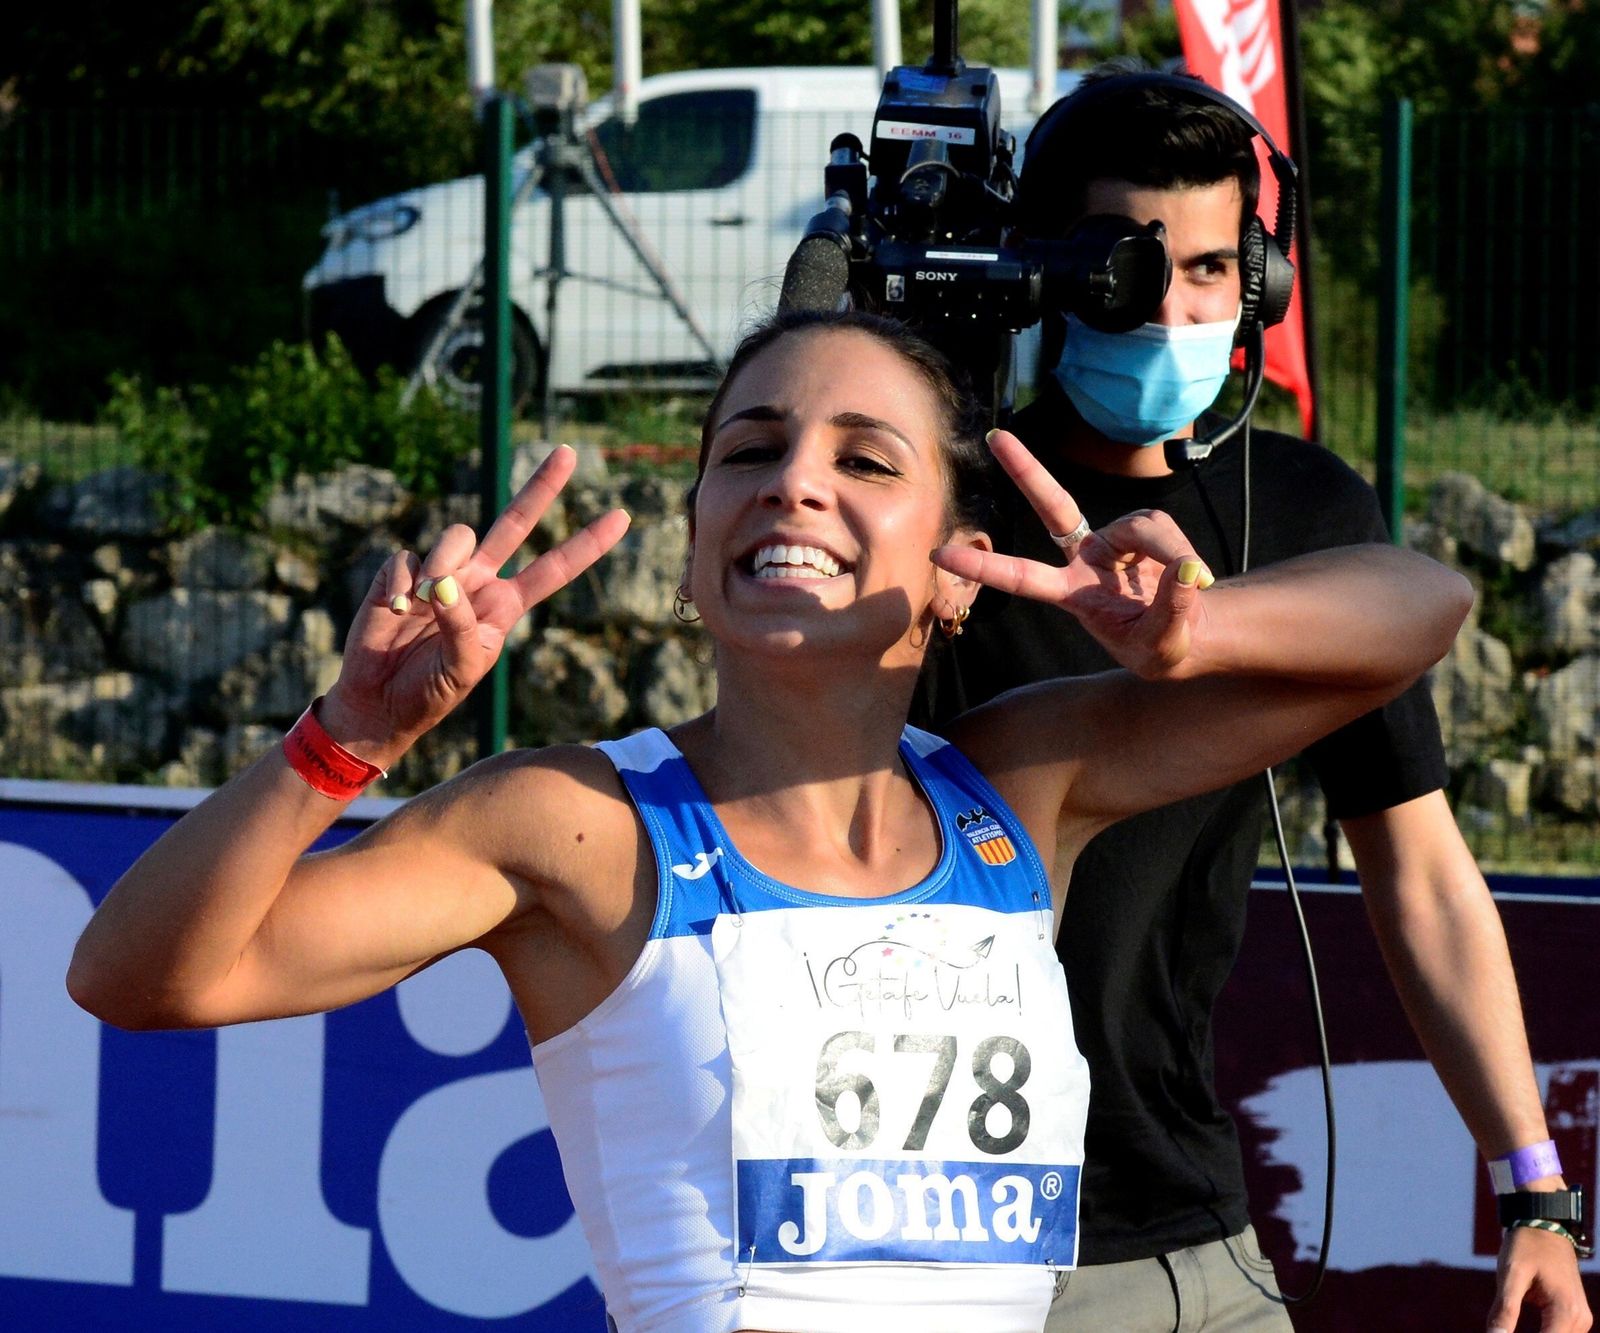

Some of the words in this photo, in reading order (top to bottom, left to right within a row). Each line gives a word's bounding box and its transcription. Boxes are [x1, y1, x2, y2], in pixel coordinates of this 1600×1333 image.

[915, 271, 958, 281] SONY
[972, 829, 1004, 844] ATLETISMO
[815, 1030, 1032, 1155] 678
